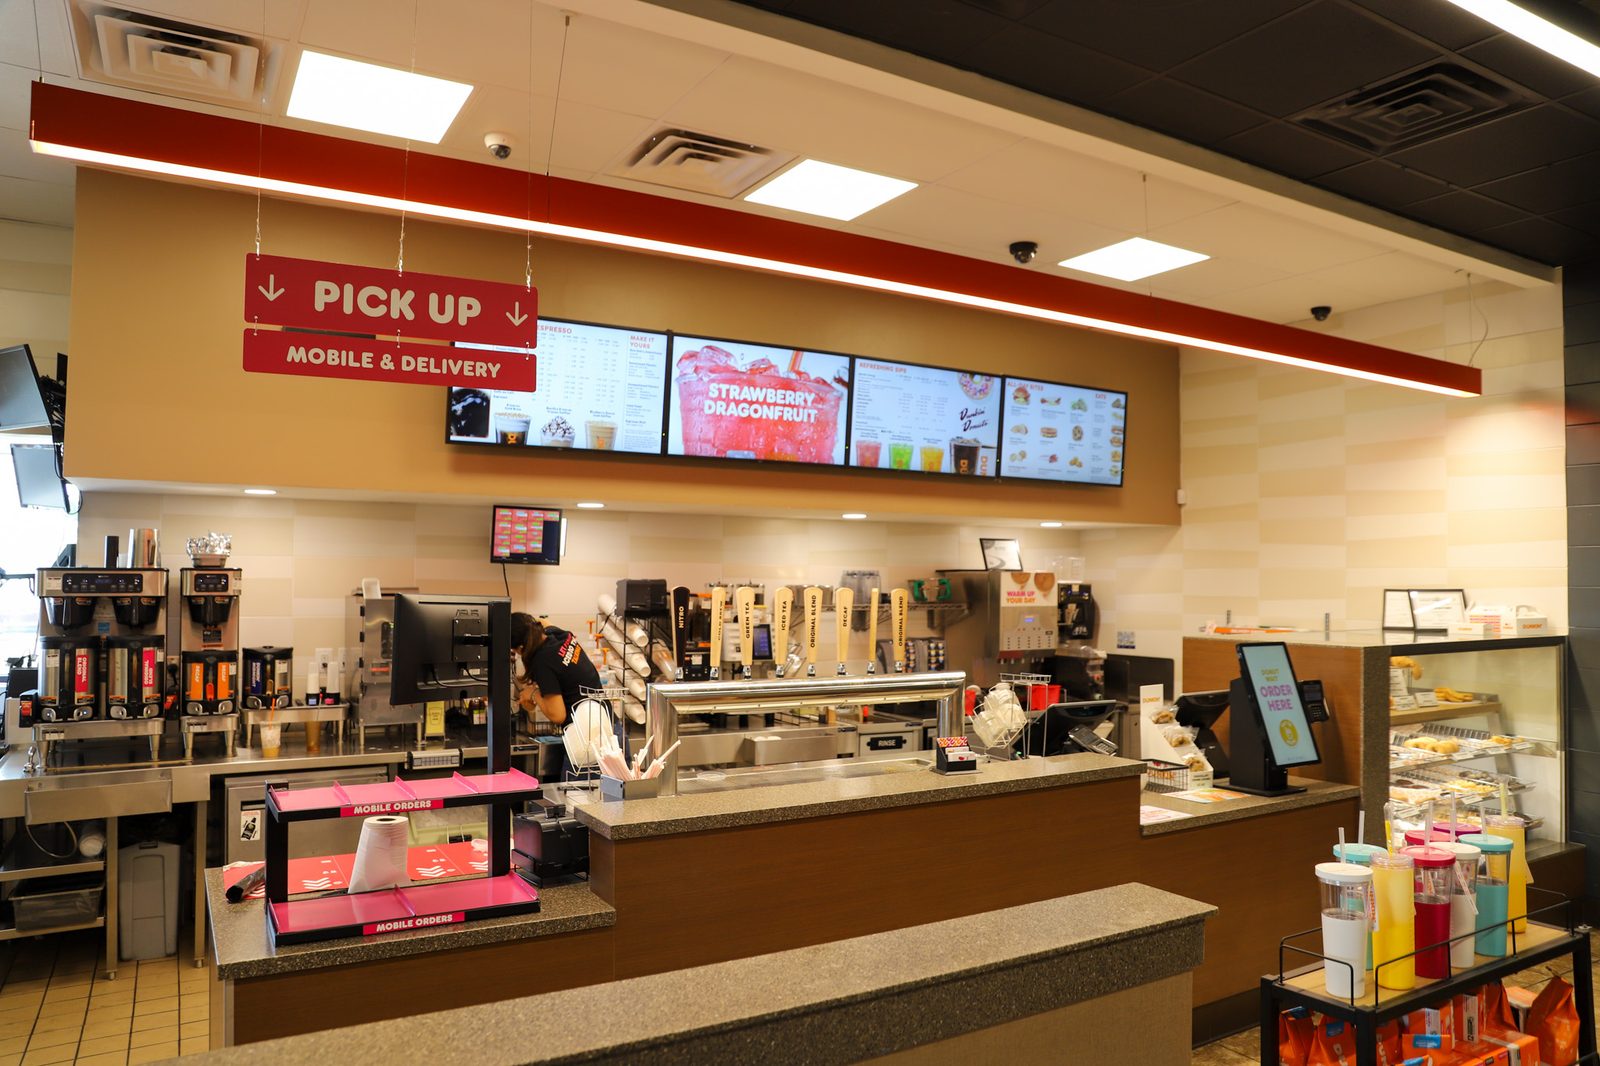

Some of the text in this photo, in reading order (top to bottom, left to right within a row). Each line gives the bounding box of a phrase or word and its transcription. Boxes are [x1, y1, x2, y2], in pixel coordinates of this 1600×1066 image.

[314, 280, 482, 327] PICK UP
[630, 335, 648, 343] MAKE
[286, 345, 501, 378] MOBILE & DELIVERY
[708, 383, 816, 407] STRAWBERRY
[703, 401, 818, 423] DRAGONFRUIT
[1260, 684, 1293, 697] ORDER
[1267, 699, 1293, 711] HERE
[353, 800, 432, 814] MOBILE ORDERS
[376, 914, 453, 932] MOBILE ORDERS
